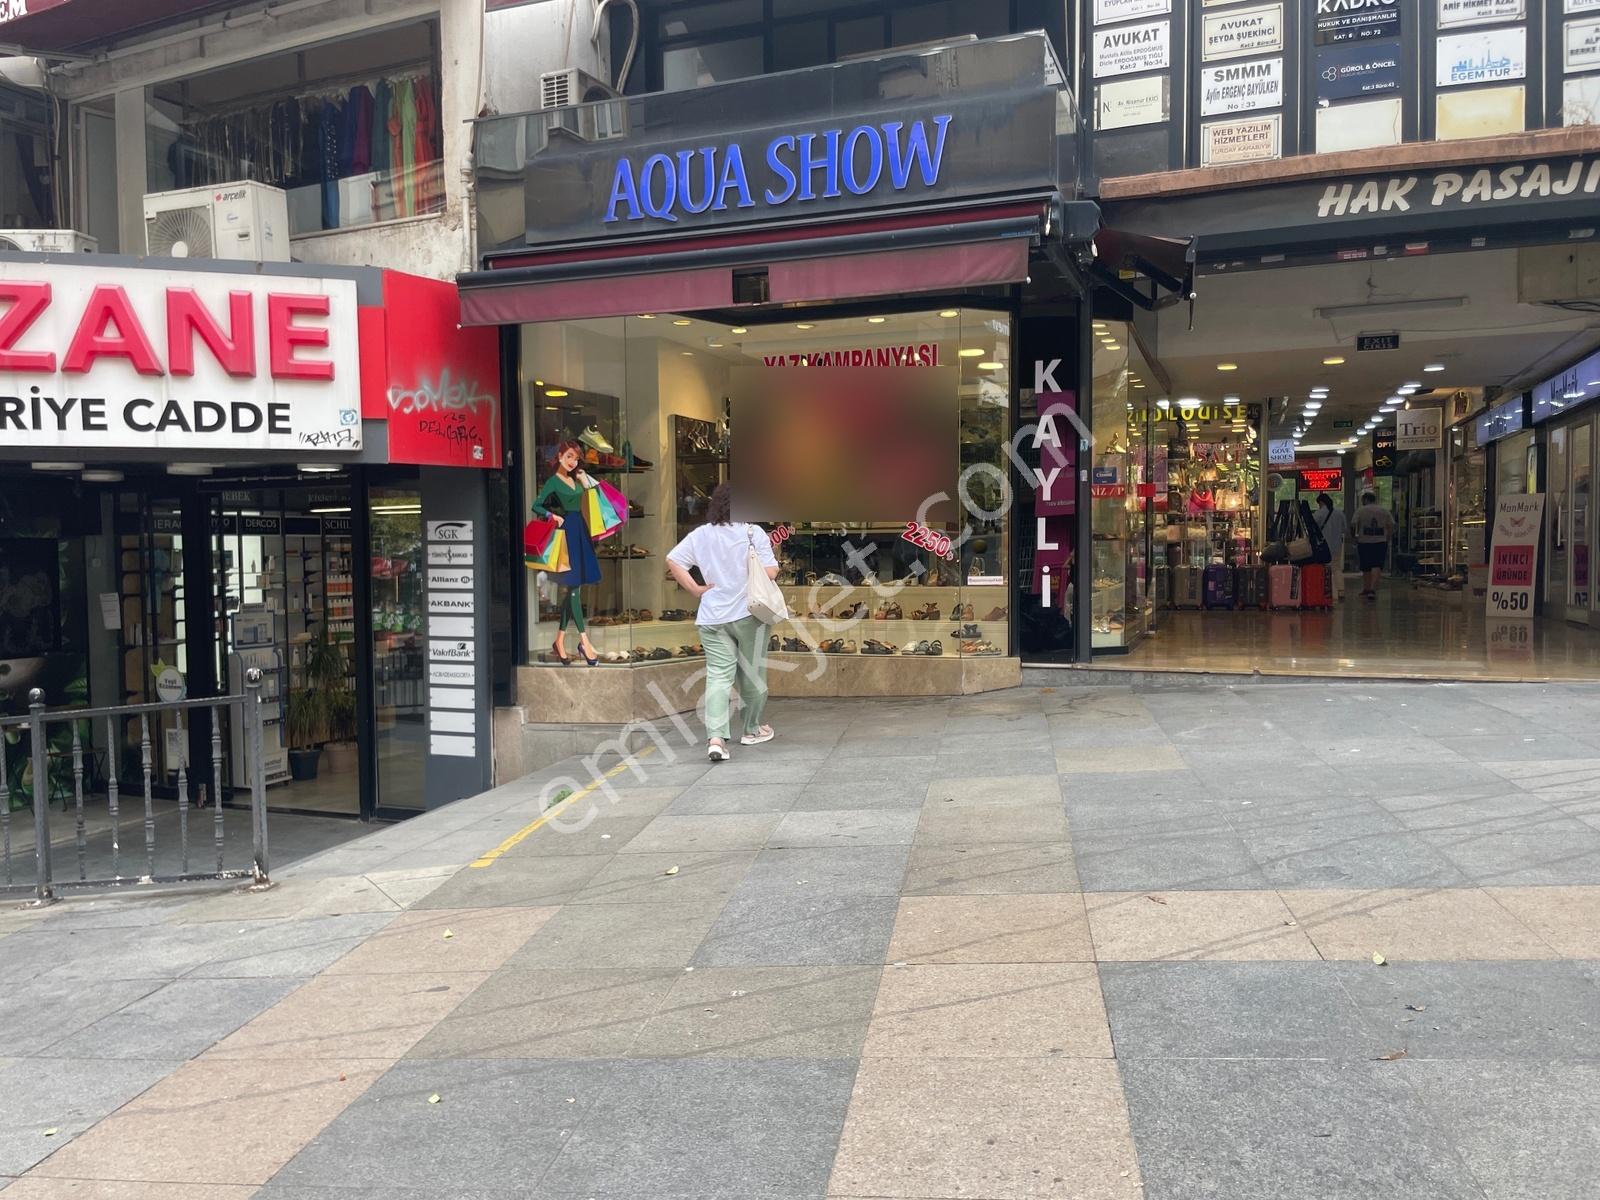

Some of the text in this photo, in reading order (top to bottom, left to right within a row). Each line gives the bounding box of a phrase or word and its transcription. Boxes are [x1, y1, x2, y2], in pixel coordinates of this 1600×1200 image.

[1220, 17, 1264, 31] AVUKAT
[1317, 19, 1341, 29] HUKUK
[1103, 28, 1160, 49] AVUKAT
[1208, 34, 1235, 46] ŞEYDA
[1213, 63, 1272, 83] SMMM
[1340, 65, 1365, 73] GÜROL
[1372, 60, 1396, 69] ÖNCEL
[1451, 70, 1485, 81] EGEM
[1488, 67, 1511, 77] TUR
[1246, 79, 1279, 97] BAYÜLKEN
[1212, 124, 1271, 137] WEB YAZILIM
[1214, 131, 1268, 145] HİZMETLERİ
[603, 114, 953, 222] AQUA SHOW
[1317, 176, 1418, 218] HAK
[0, 280, 335, 381] ZANE
[123, 398, 292, 434] CADDE
[1398, 422, 1438, 436] Trio
[1499, 501, 1539, 513] MonMark
[245, 518, 278, 529] DERCOS
[437, 529, 459, 540] SGK
[430, 600, 471, 608] AKBANK
[1491, 591, 1529, 612] %50
